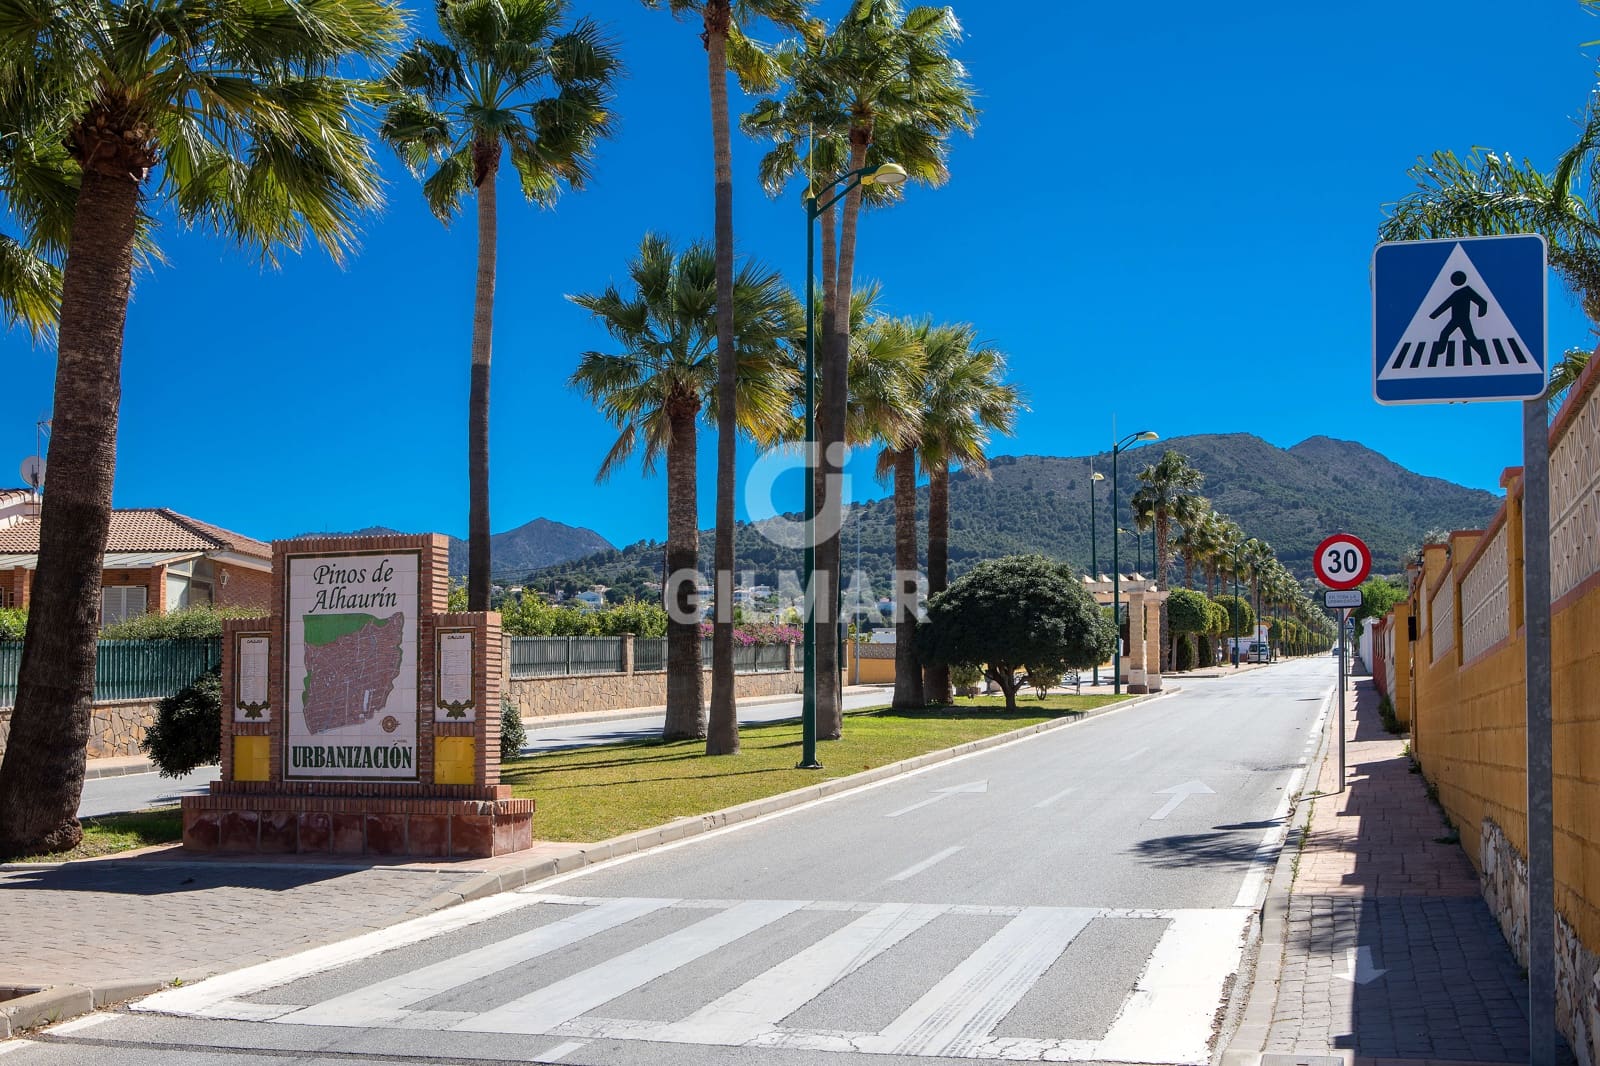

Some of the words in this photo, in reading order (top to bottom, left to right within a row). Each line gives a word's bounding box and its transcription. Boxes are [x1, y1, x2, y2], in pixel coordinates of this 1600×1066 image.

[313, 563, 367, 585] Pinos
[371, 559, 394, 582] de
[1328, 549, 1358, 574] 30
[308, 586, 397, 613] Alhaurín
[292, 743, 413, 769] URBANIZACIÓN
